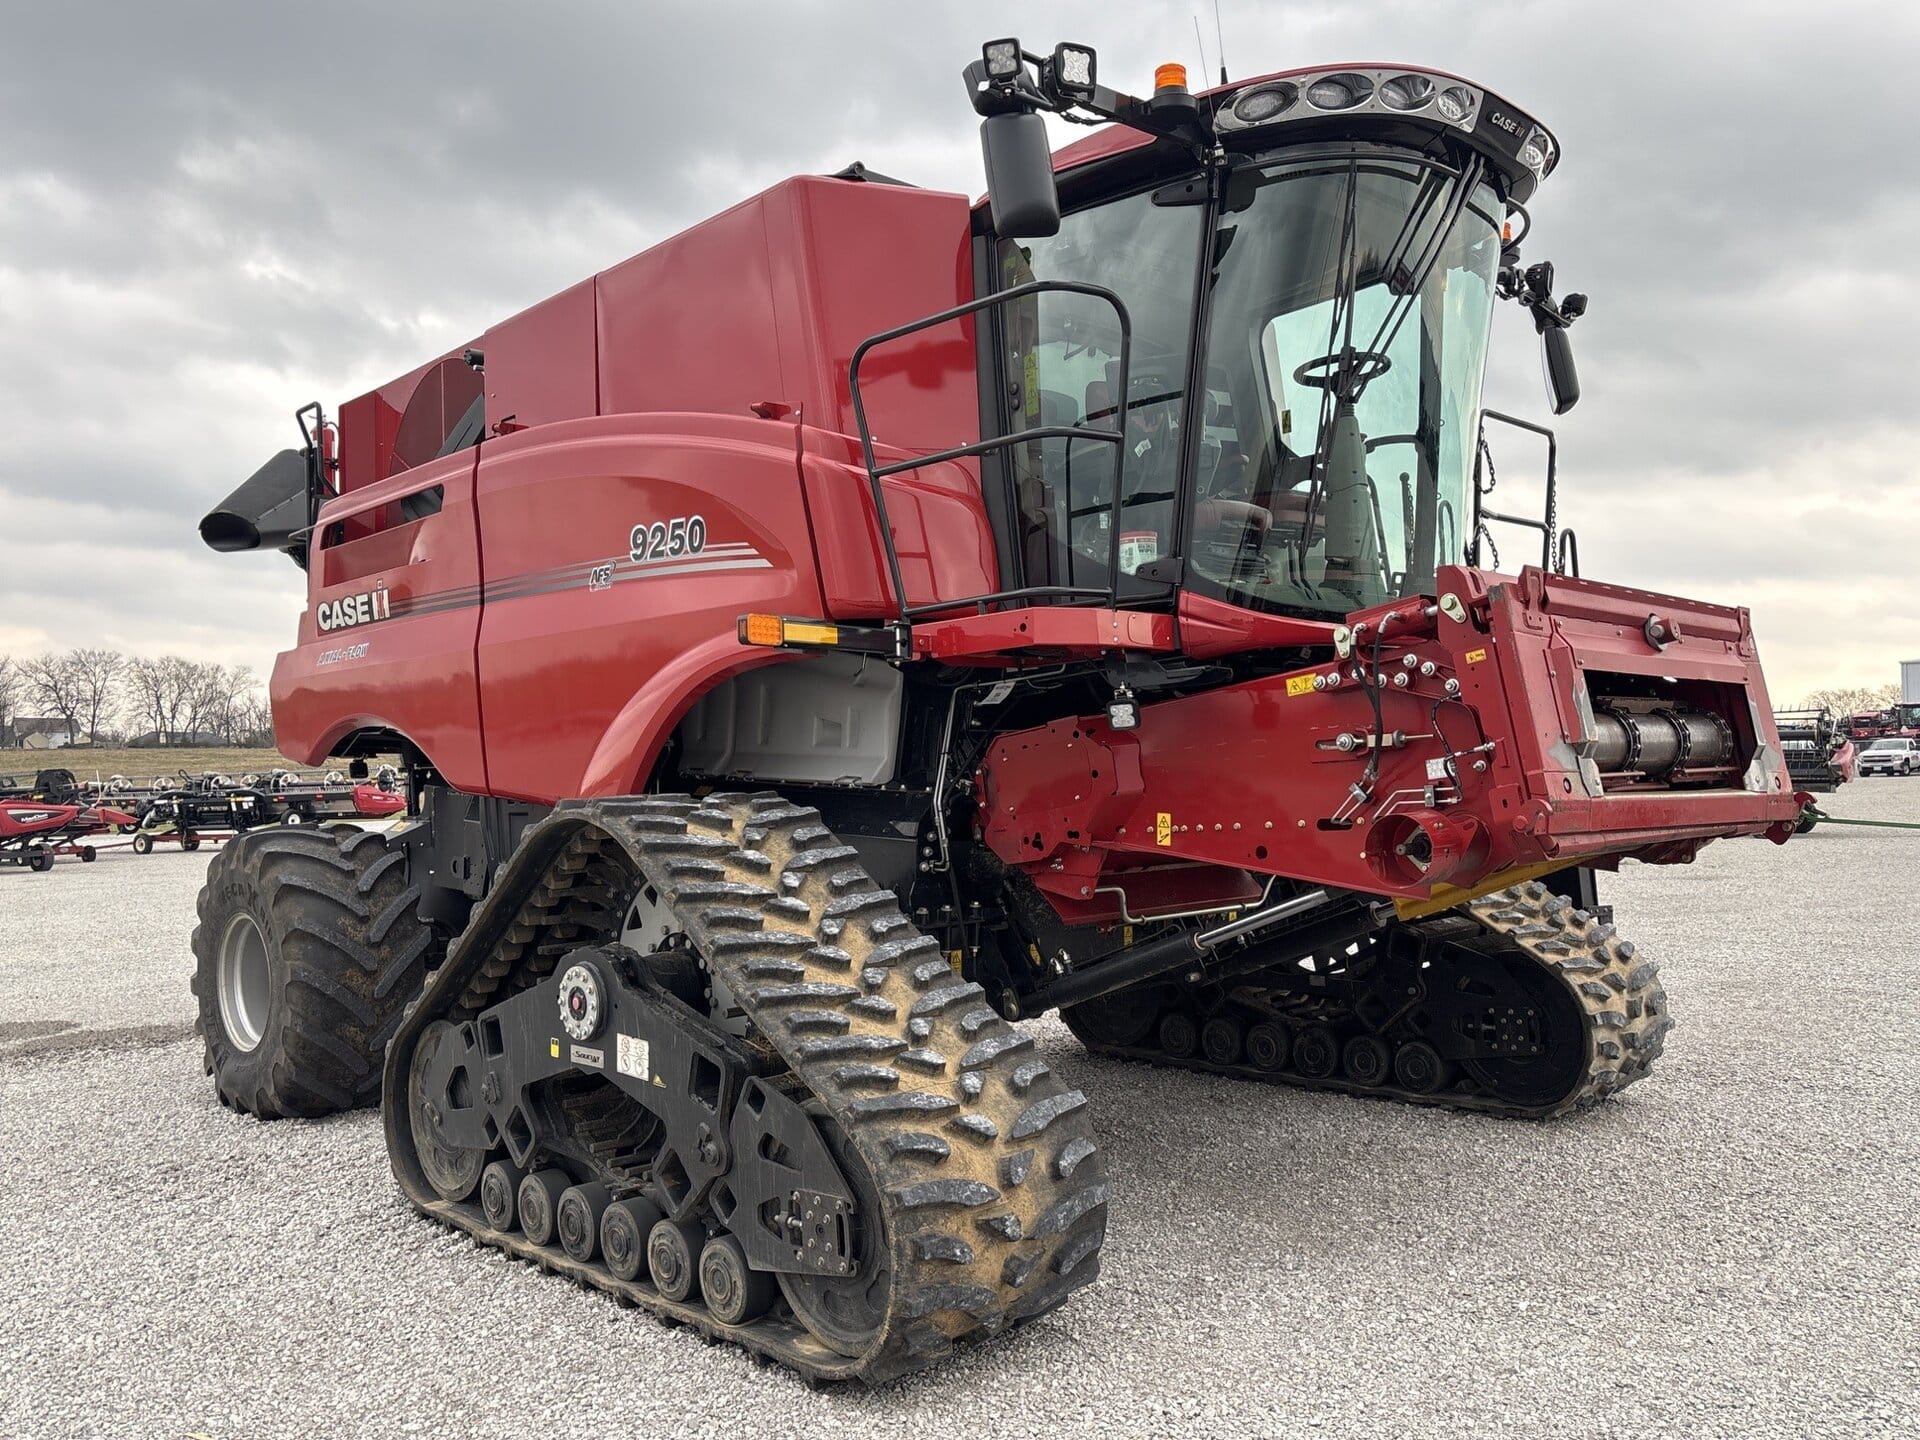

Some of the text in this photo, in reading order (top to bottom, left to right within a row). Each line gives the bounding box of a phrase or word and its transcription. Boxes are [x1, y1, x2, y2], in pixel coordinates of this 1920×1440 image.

[1491, 112, 1517, 133] CASE
[630, 515, 706, 563] 9250
[589, 563, 612, 585] AFS
[317, 593, 371, 631] CASE
